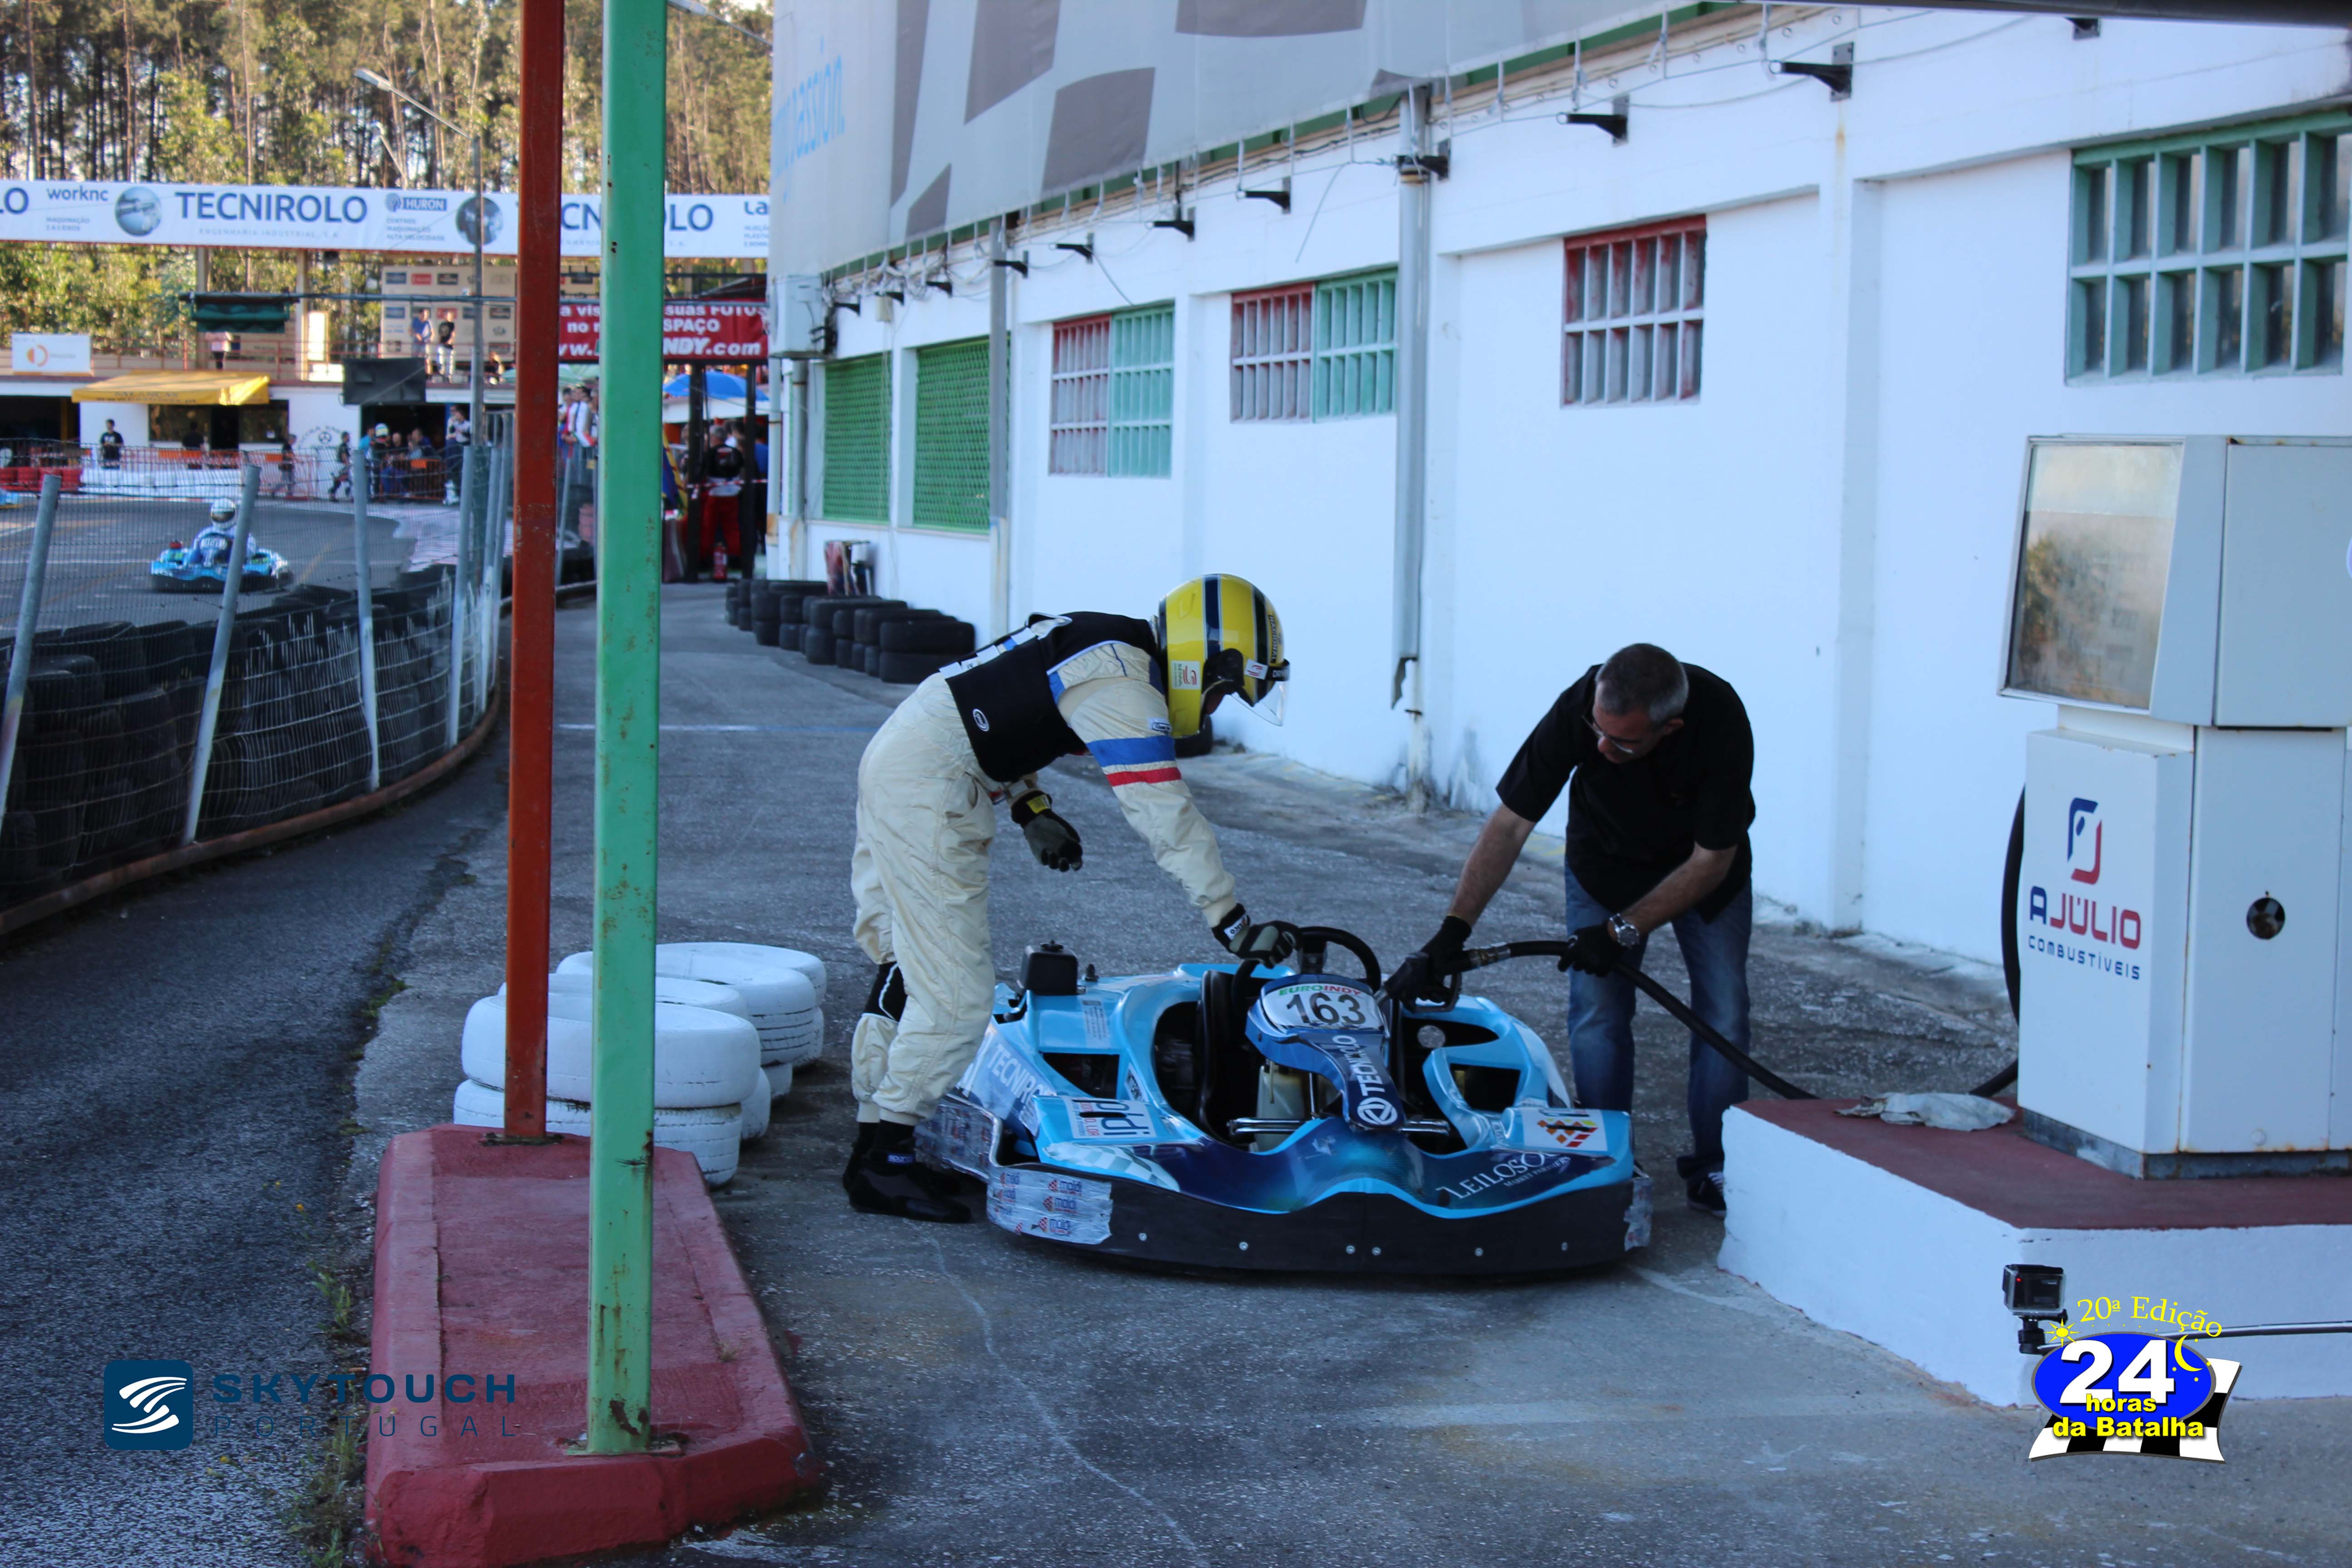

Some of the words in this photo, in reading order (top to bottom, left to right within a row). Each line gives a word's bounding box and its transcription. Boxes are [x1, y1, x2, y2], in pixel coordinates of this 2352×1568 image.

[47, 185, 108, 201] worknc
[407, 199, 444, 210] HURON
[174, 191, 368, 224] TECNIROLO
[567, 322, 589, 333] no
[663, 318, 720, 334] SPAÇO
[2029, 935, 2141, 980] COMBUSTÍVEIS
[1279, 984, 1362, 996] EUROINDY
[1286, 992, 1366, 1025] 163
[1435, 1151, 1558, 1199] LEILOSO
